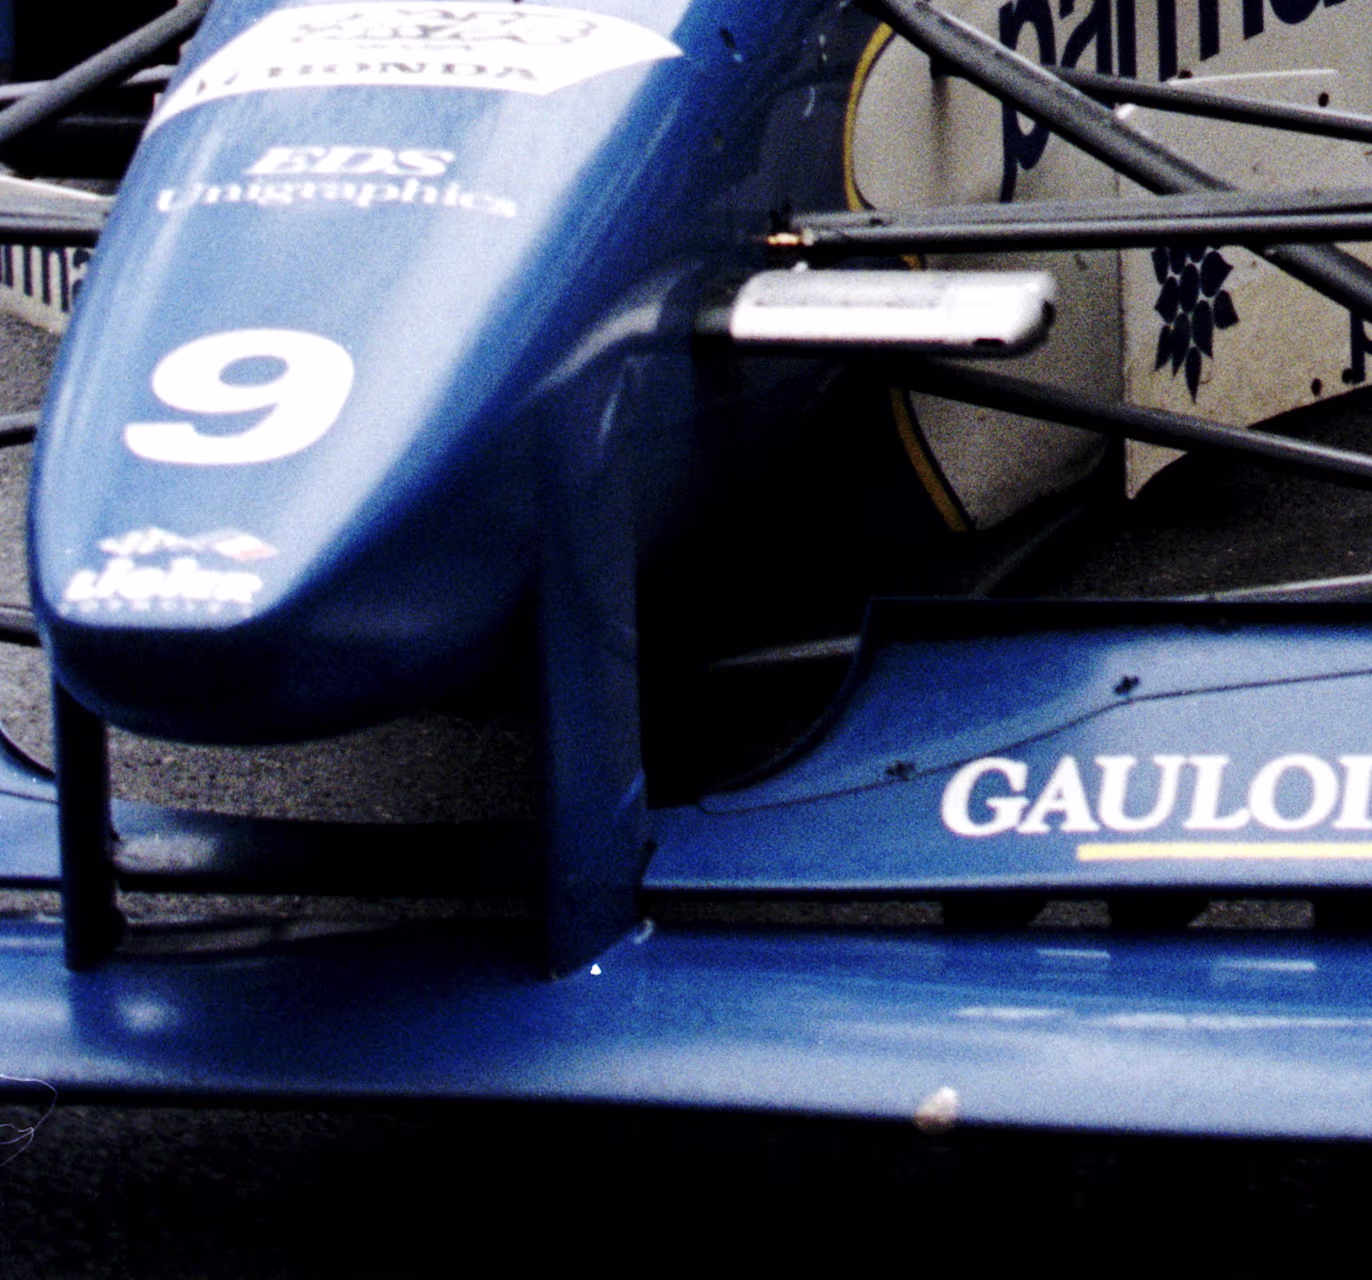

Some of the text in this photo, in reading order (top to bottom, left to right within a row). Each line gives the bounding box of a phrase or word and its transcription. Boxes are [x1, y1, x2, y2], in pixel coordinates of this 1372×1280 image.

[267, 61, 540, 82] HONDA
[244, 145, 455, 176] EDS
[156, 177, 517, 219] Unigraphics
[124, 328, 354, 465] 9
